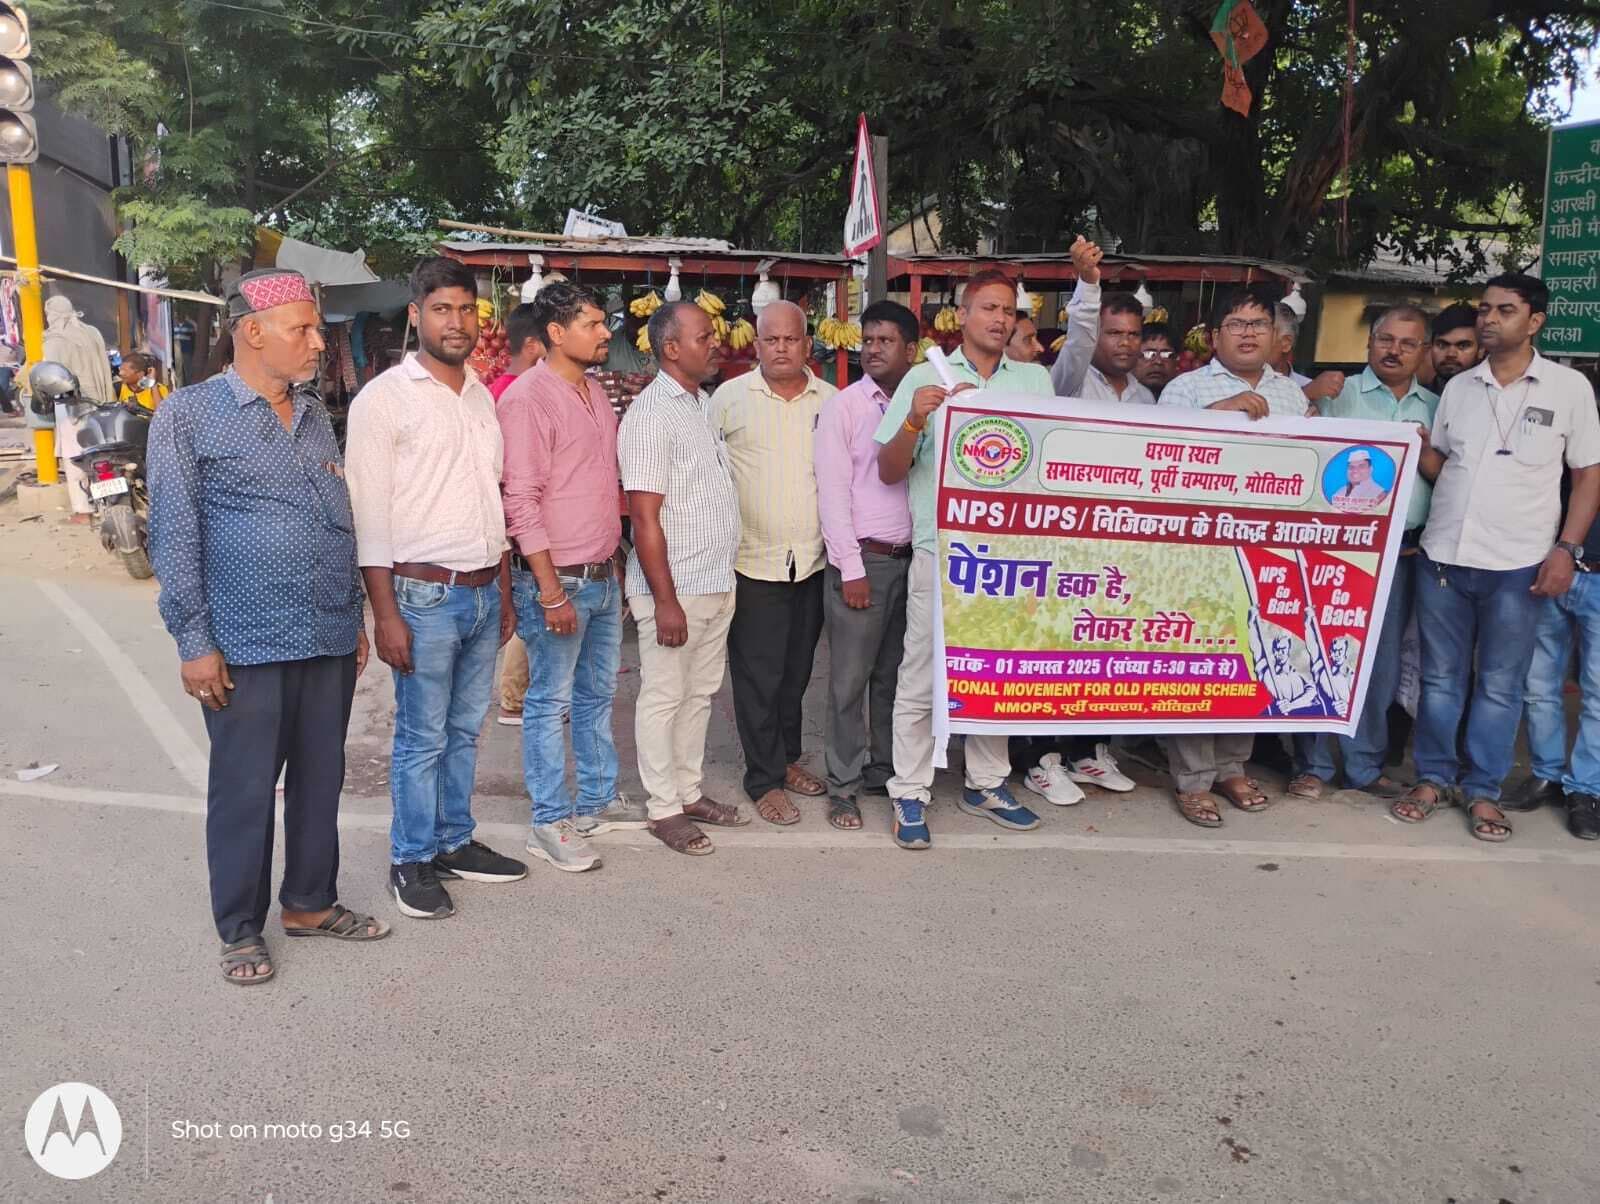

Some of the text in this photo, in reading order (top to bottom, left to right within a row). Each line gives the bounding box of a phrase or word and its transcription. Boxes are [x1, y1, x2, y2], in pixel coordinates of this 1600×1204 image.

[1551, 189, 1597, 213] आरक्षी
[1550, 216, 1581, 240] गाँधी
[1548, 250, 1600, 267] समाहर
[1546, 267, 1597, 293] कचहरी
[1188, 446, 1222, 464] स्थल
[1046, 462, 1304, 496] समाहरणालय, पूर्वी चम्पारण, मोतिहारी
[1092, 505, 1188, 537] निजिकरण
[1191, 511, 1212, 538] के
[1215, 512, 1270, 543] विरुद्ध
[1273, 518, 1341, 544] आक्रोश
[1343, 520, 1379, 546] मार्च
[948, 542, 1132, 605] पेंशन हक है,
[1258, 566, 1287, 584] NPS
[1311, 565, 1346, 587] UPS
[1275, 585, 1291, 599] Go
[1331, 588, 1351, 606] Go
[1266, 598, 1301, 615] Back
[1320, 605, 1368, 628] Back
[1072, 608, 1137, 642] लेकर
[946, 653, 990, 672] नांक-
[995, 658, 1013, 674] 01
[1017, 660, 1064, 675] अगस्त
[1066, 658, 1101, 675] 2025
[1152, 659, 1186, 675] 5:30
[1189, 658, 1215, 676] बजे
[1218, 658, 1238, 679] से)
[947, 679, 1257, 698] TIONAL MOVEMENT FOR OLD PENSION SCHEME
[994, 702, 1057, 716] NMOPS,
[1060, 700, 1088, 716] पूर्वी
